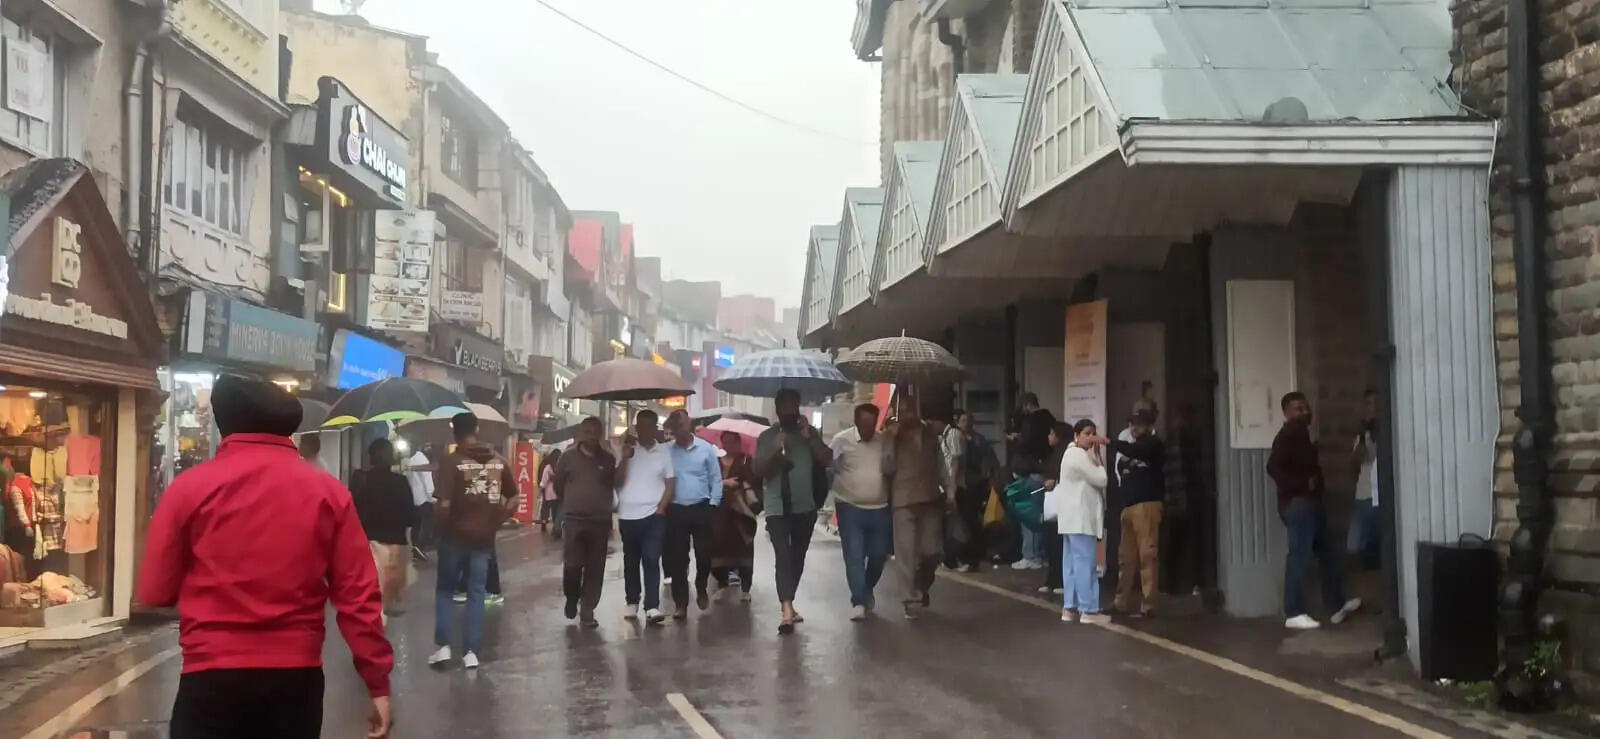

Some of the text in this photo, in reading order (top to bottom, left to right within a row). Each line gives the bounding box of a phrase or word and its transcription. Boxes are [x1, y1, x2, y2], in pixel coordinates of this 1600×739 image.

[363, 137, 386, 177] CHAI
[554, 373, 571, 393] OCT
[517, 451, 530, 514] SALE
